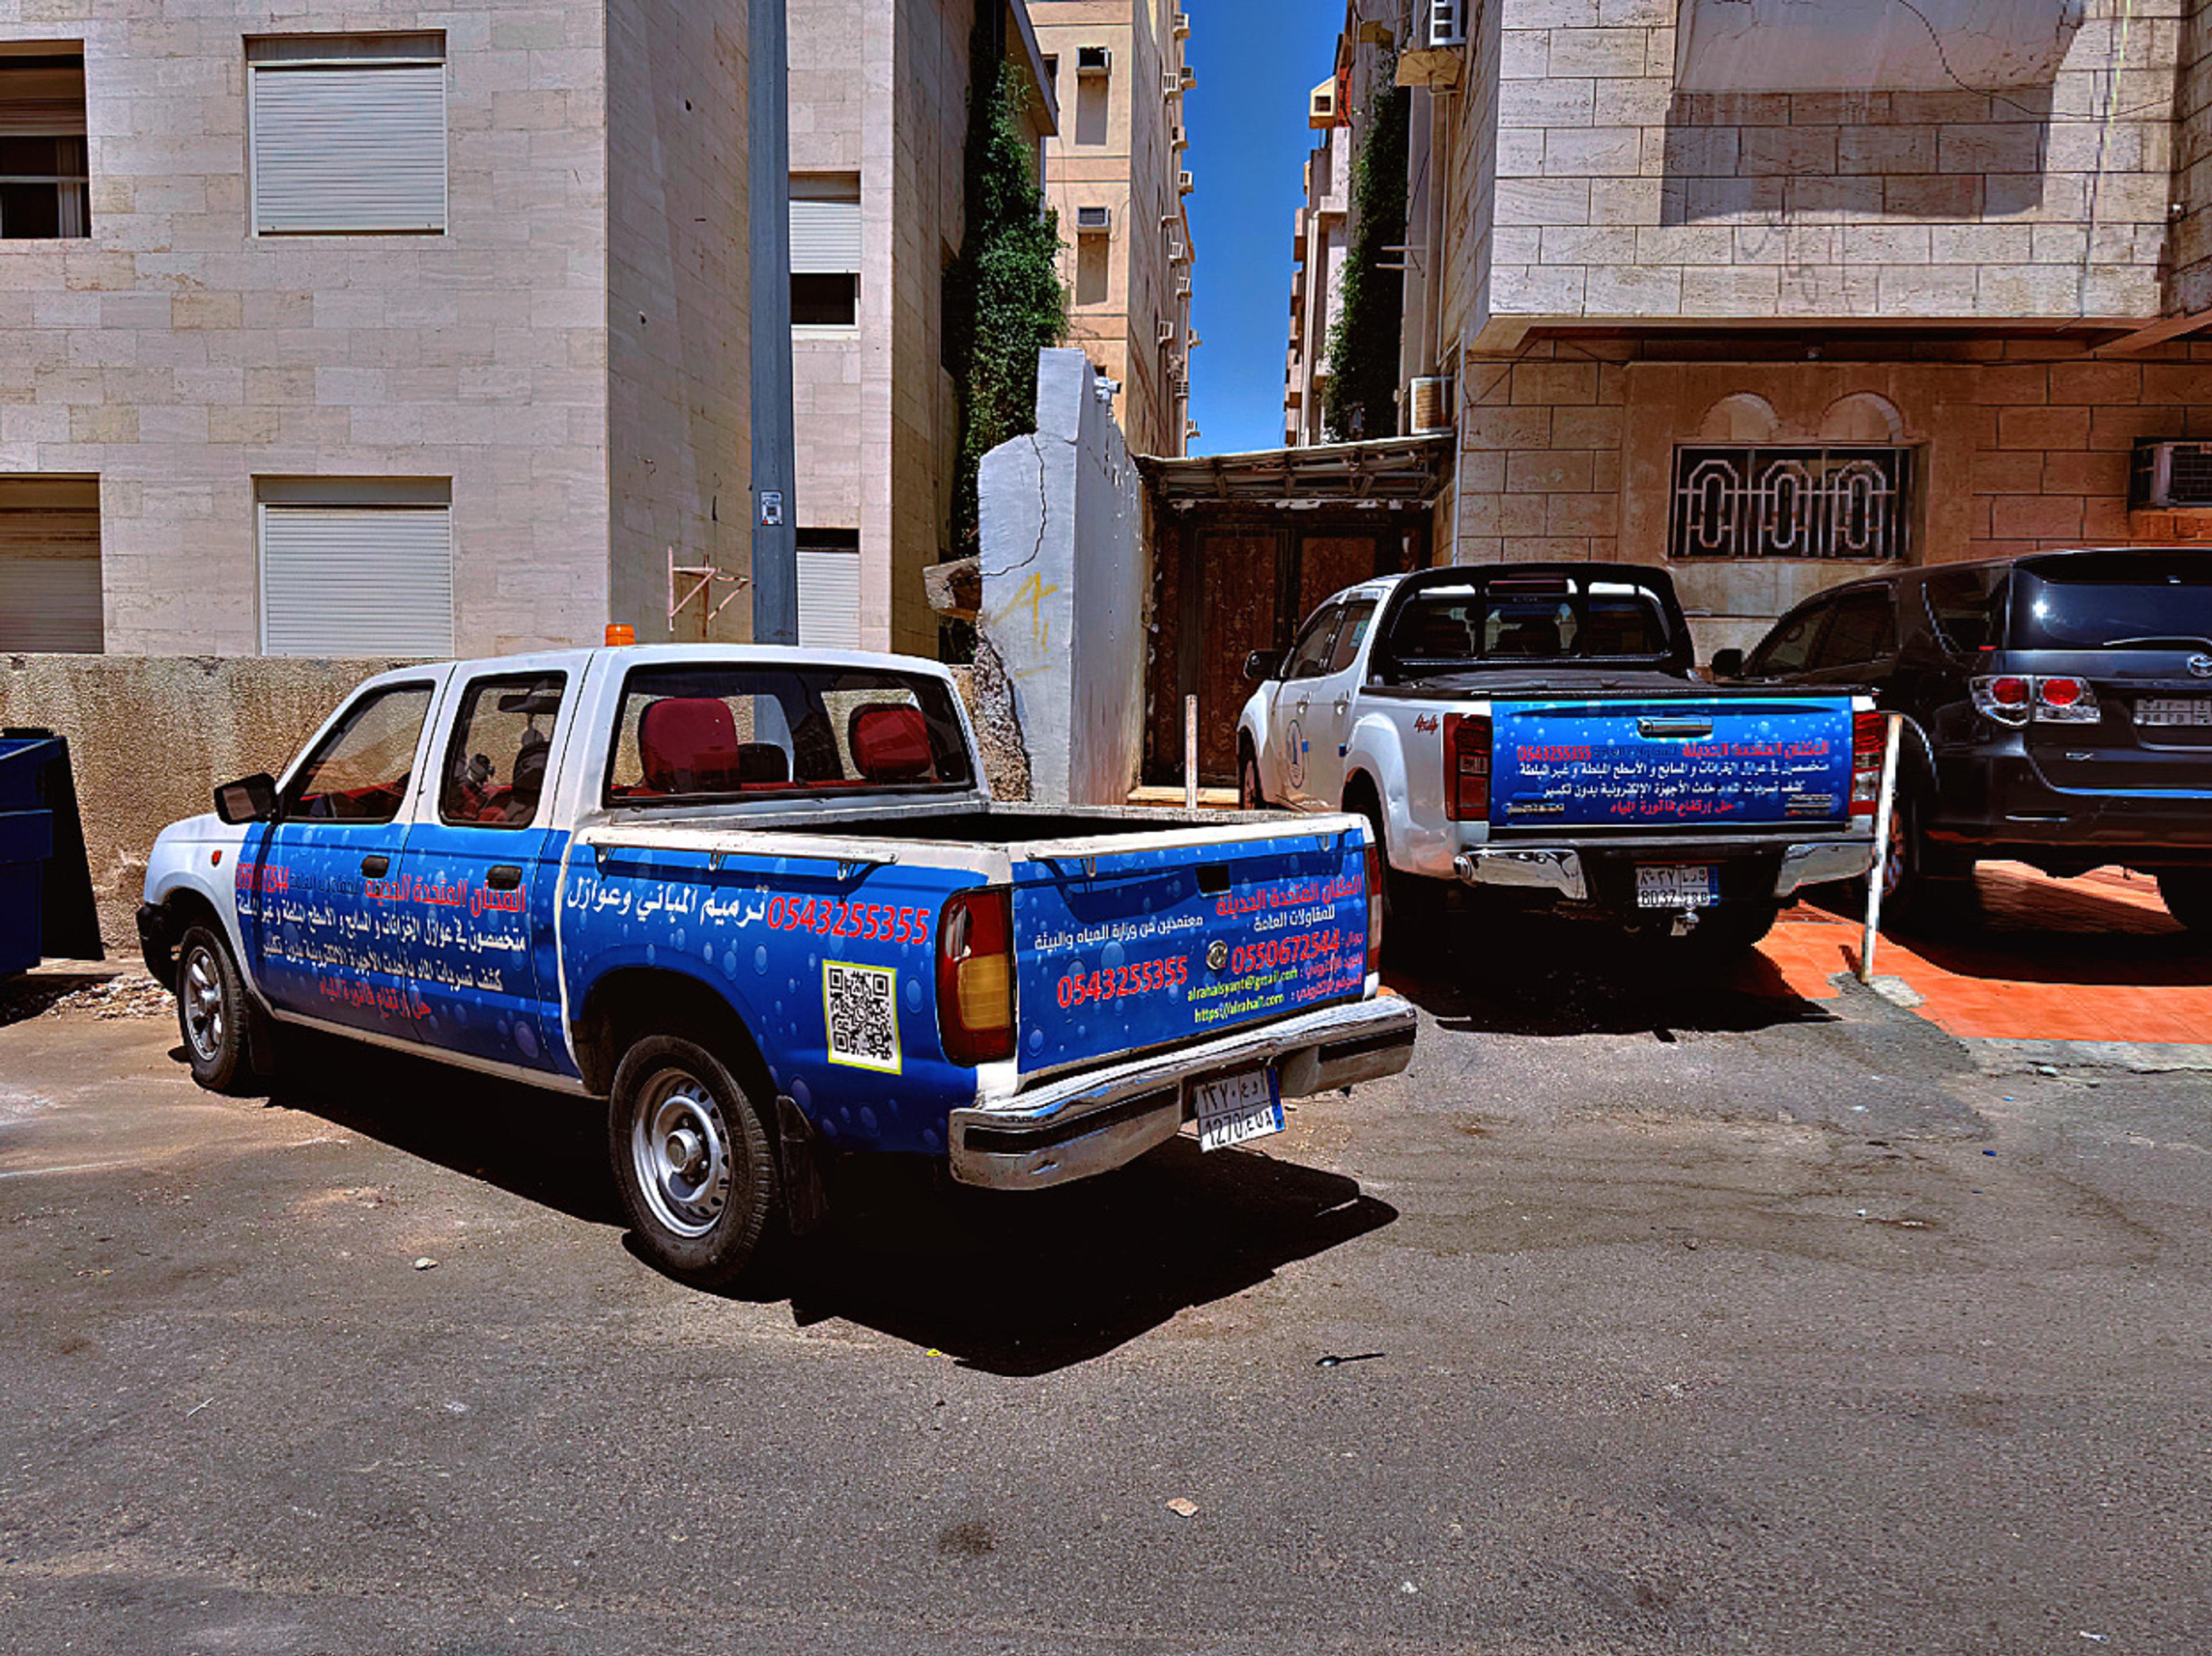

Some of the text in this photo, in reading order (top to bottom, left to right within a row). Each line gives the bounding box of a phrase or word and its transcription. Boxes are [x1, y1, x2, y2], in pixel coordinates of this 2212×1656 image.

[1517, 745, 1592, 762] 0543255355
[567, 876, 770, 927] ترميم المباني وعوازل
[1216, 889, 1266, 920] الحديثة
[1269, 881, 1319, 907] المتحدة
[767, 896, 930, 945] 0543255355
[1034, 914, 1203, 952] معتمدين من وزارة المياه والبيئة
[1253, 911, 1287, 933] العامة
[1231, 927, 1340, 975] 0550672544
[1057, 956, 1188, 1008] 0543255355
[1206, 1112, 1243, 1146] 1270
